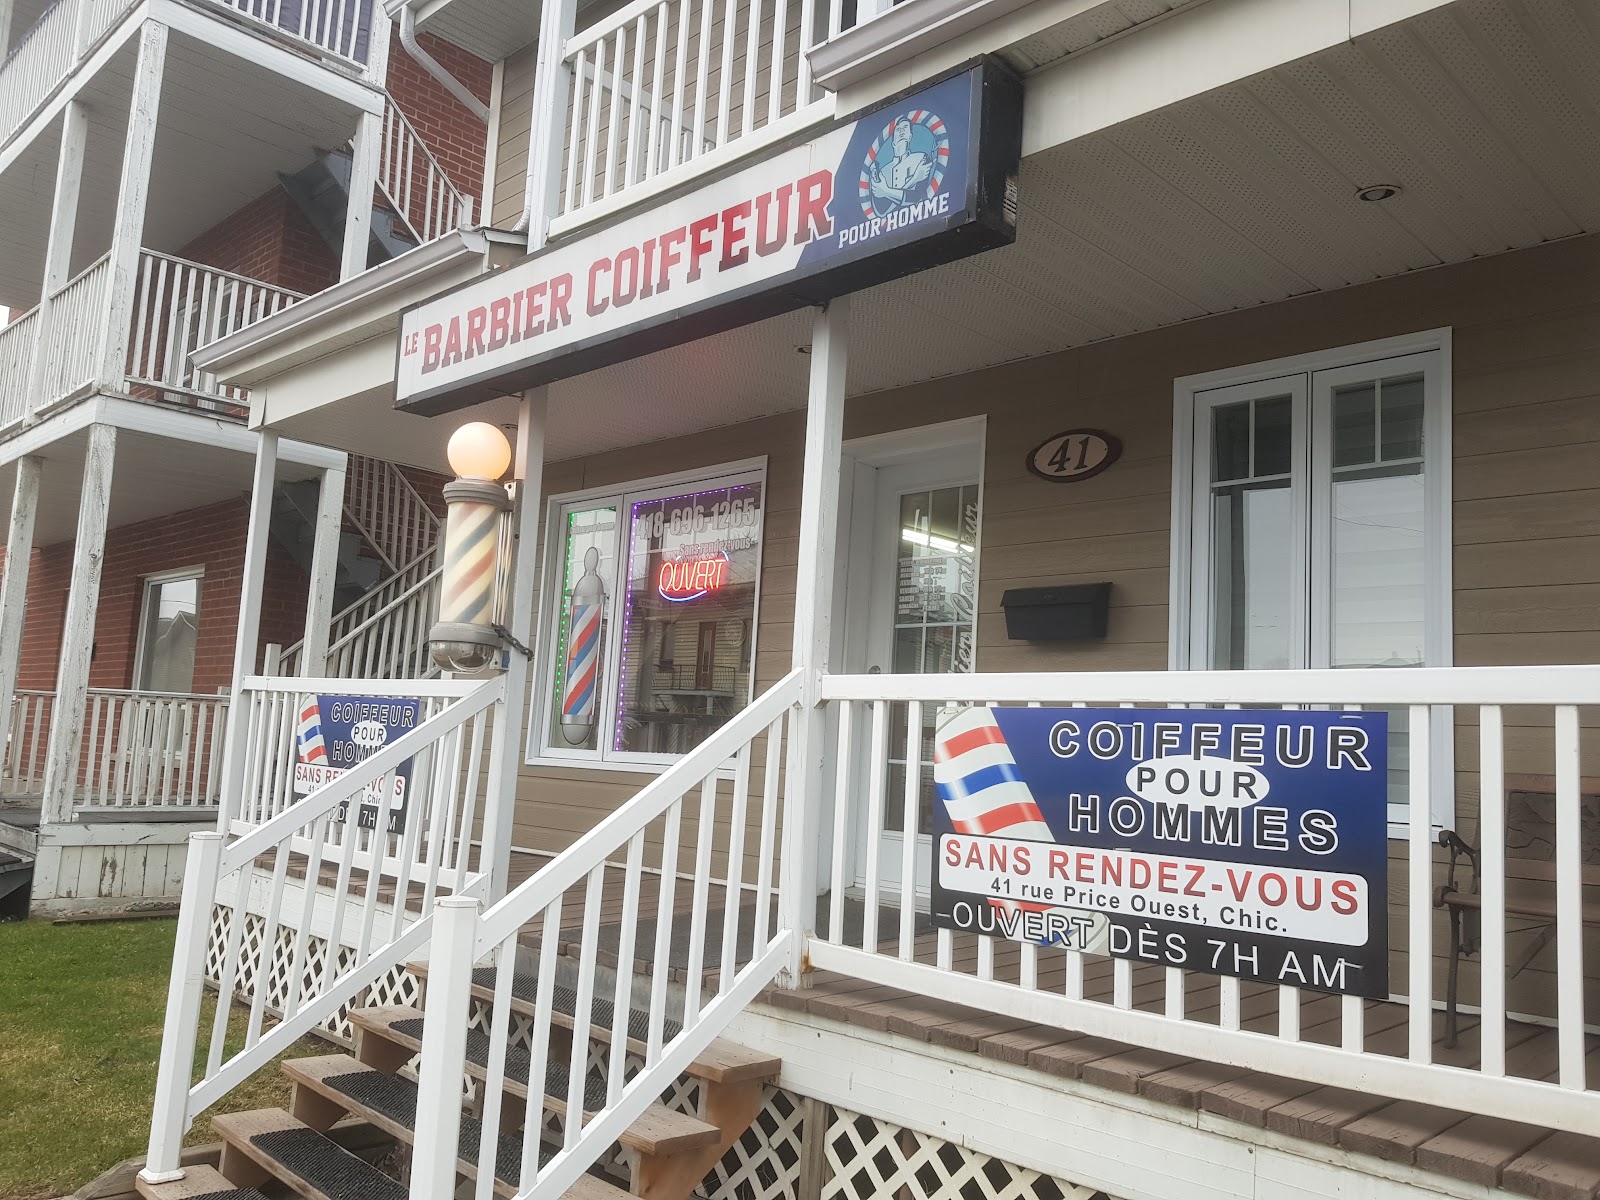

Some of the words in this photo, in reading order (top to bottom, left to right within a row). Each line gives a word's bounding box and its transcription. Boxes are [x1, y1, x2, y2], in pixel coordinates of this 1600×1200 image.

[839, 216, 882, 249] POUR
[885, 191, 950, 233] HOMME
[404, 331, 418, 357] LE
[421, 272, 573, 375] BARBIER
[586, 169, 835, 318] COIFFEUR
[1047, 436, 1090, 473] 41
[636, 498, 757, 541] 418-696-1265
[659, 559, 727, 592] OUVERT
[331, 702, 415, 727] COIFFEUR
[353, 726, 385, 741] POUR
[1049, 720, 1372, 771] COIFFEUR
[296, 765, 321, 784] SANS
[1136, 767, 1258, 799] POUR
[362, 811, 376, 828] 7H
[1069, 794, 1339, 855] HOMMES
[945, 839, 1031, 876] SANS
[1048, 849, 1359, 916] RENDEZ-VOUS
[990, 876, 1012, 894] 41
[1021, 884, 1054, 901] rue
[1063, 885, 1121, 909] Price
[1130, 894, 1208, 925] Ouest,
[1219, 906, 1288, 933] Chic.
[952, 901, 1094, 949] OUVERT
[1109, 922, 1188, 963] DÈS
[1206, 939, 1259, 975] 7H
[1278, 951, 1347, 990] AM
